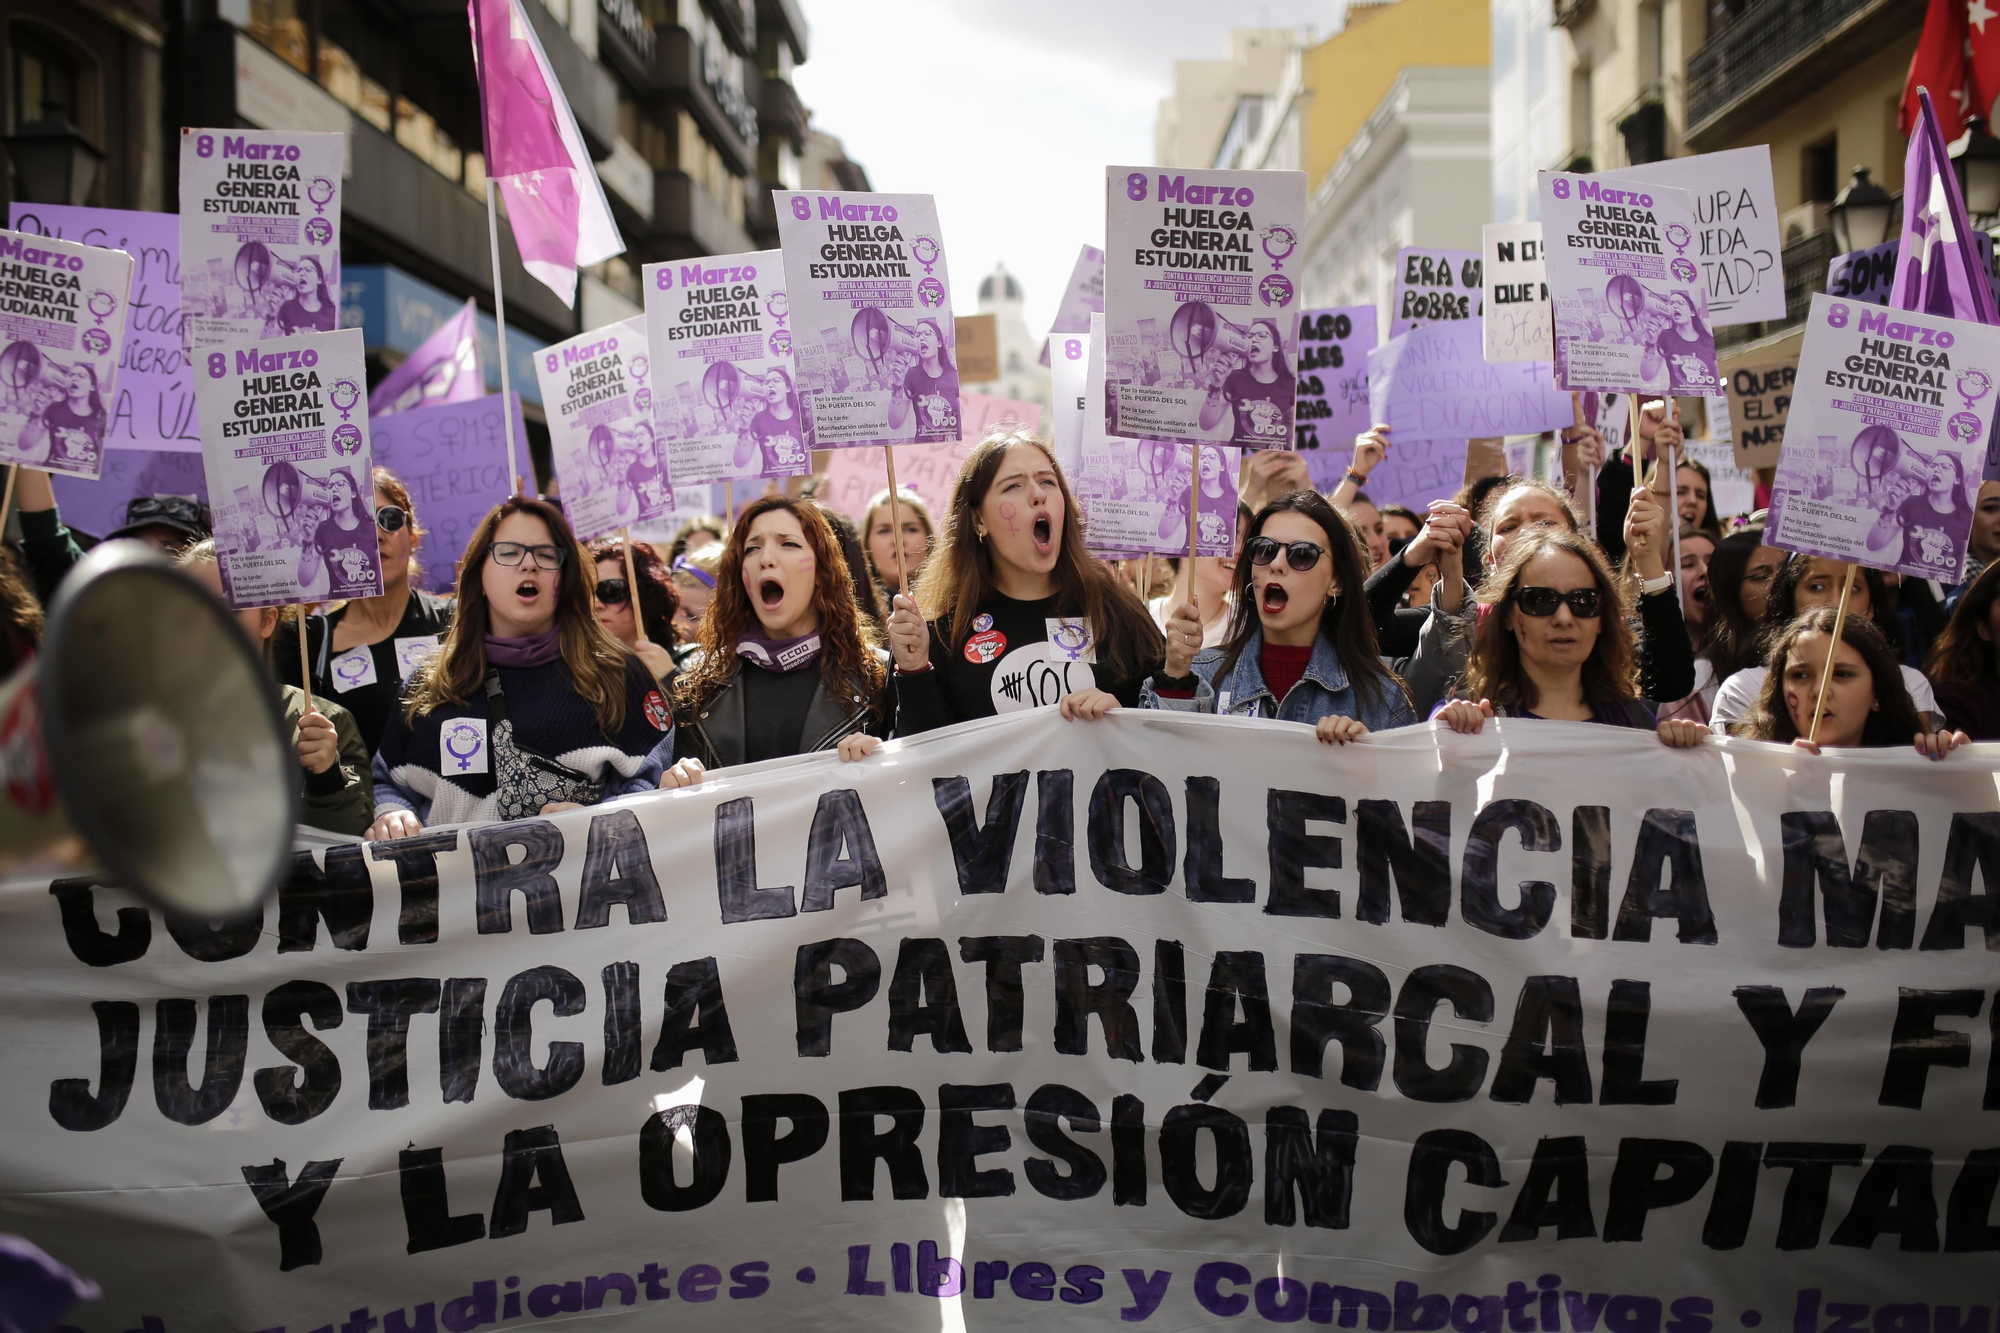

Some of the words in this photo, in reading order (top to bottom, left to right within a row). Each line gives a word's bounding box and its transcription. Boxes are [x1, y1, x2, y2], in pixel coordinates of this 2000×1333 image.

[197, 135, 214, 158] 8
[224, 136, 300, 162] Marzo
[228, 163, 300, 181] HUELGA
[216, 181, 300, 199] GENERAL
[1128, 173, 1148, 201] 8
[1159, 175, 1254, 207] Marzo
[1554, 179, 1570, 199] 8
[1579, 180, 1653, 208] Marzo
[204, 199, 300, 215] ESTUDIANTIL
[792, 196, 810, 220] 8
[819, 197, 898, 222] Marzo
[1164, 208, 1254, 230] HUELGA
[1586, 204, 1657, 225] HUELGA
[1693, 188, 1757, 224] URA
[828, 225, 904, 242] HUELGA
[1151, 229, 1253, 252] GENERAL
[1578, 220, 1660, 241] GENERAL
[0, 236, 84, 272] Marzo
[821, 244, 907, 261] GENERAL
[1497, 240, 1545, 262] NO
[1568, 235, 1663, 254] ESTUDIANTIL
[810, 263, 910, 278] ESTUDIANTIL
[1136, 249, 1253, 272] ESTUDIANTIL
[1404, 255, 1453, 286] ERA
[1461, 258, 1482, 288] U
[1701, 250, 1773, 297] TAD?
[1832, 249, 1899, 297] SOM
[0, 262, 80, 291] HUELGA
[658, 268, 673, 290] 8
[682, 264, 756, 286] Marzo
[688, 284, 758, 305] HUELGA
[1401, 290, 1470, 320] POBRE
[1494, 284, 1534, 304] QUE
[0, 298, 77, 323] UDIANTIL
[680, 302, 760, 323] GENERAL
[669, 319, 762, 340] ESTUDIANTIL
[1298, 314, 1352, 341] LGO
[1828, 304, 1848, 328] 8
[1859, 310, 1954, 348] Marzo
[208, 353, 226, 378] 8
[236, 350, 318, 375] Marzo
[547, 354, 558, 373] 8
[564, 338, 618, 366] Marzo
[1397, 334, 1462, 371] ONTRA
[1861, 338, 1950, 370] HUELGA
[570, 354, 622, 382] HUELGA
[1400, 366, 1502, 394] VIOLENCIA
[1845, 355, 1946, 390] GENERAL
[243, 371, 321, 396] HUELGA
[567, 369, 624, 398] GENERAL
[1734, 367, 1797, 396] QUER
[1826, 370, 1944, 406] ESTUDIANTIL
[158, 381, 201, 442] ÚL
[234, 392, 323, 418] GENERAL
[561, 383, 626, 414] ESTUDIANTIL
[1744, 399, 1774, 420] EL
[223, 412, 325, 437] ESTUDIANTIL
[1122, 415, 1162, 424] Manifestación
[1122, 422, 1156, 430] Movimiento
[1157, 426, 1186, 434] Feminista
[1801, 508, 1829, 518] PUERTA
[1782, 532, 1819, 545] Movimiento
[1820, 541, 1851, 552] Feminista
[1783, 525, 1827, 539] Manifestación
[1828, 535, 1852, 545] unitaria
[780, 644, 809, 662] CCOO
[714, 789, 888, 924] LA
[931, 768, 1718, 945] VIOLENCIA
[1778, 809, 2000, 951] MA
[49, 957, 739, 1131] JUSTICIA
[793, 934, 1678, 1106] PATRIARCAL
[1730, 984, 1847, 1108] Y
[1878, 986, 2000, 1111] F
[241, 1158, 345, 1272] Y
[399, 1124, 585, 1255] LA
[640, 1074, 1358, 1229] OPRESIÓN
[1404, 1127, 2000, 1256] CAPITAL
[1121, 1268, 1171, 1321] y
[1194, 1261, 1714, 1333] Combativas
